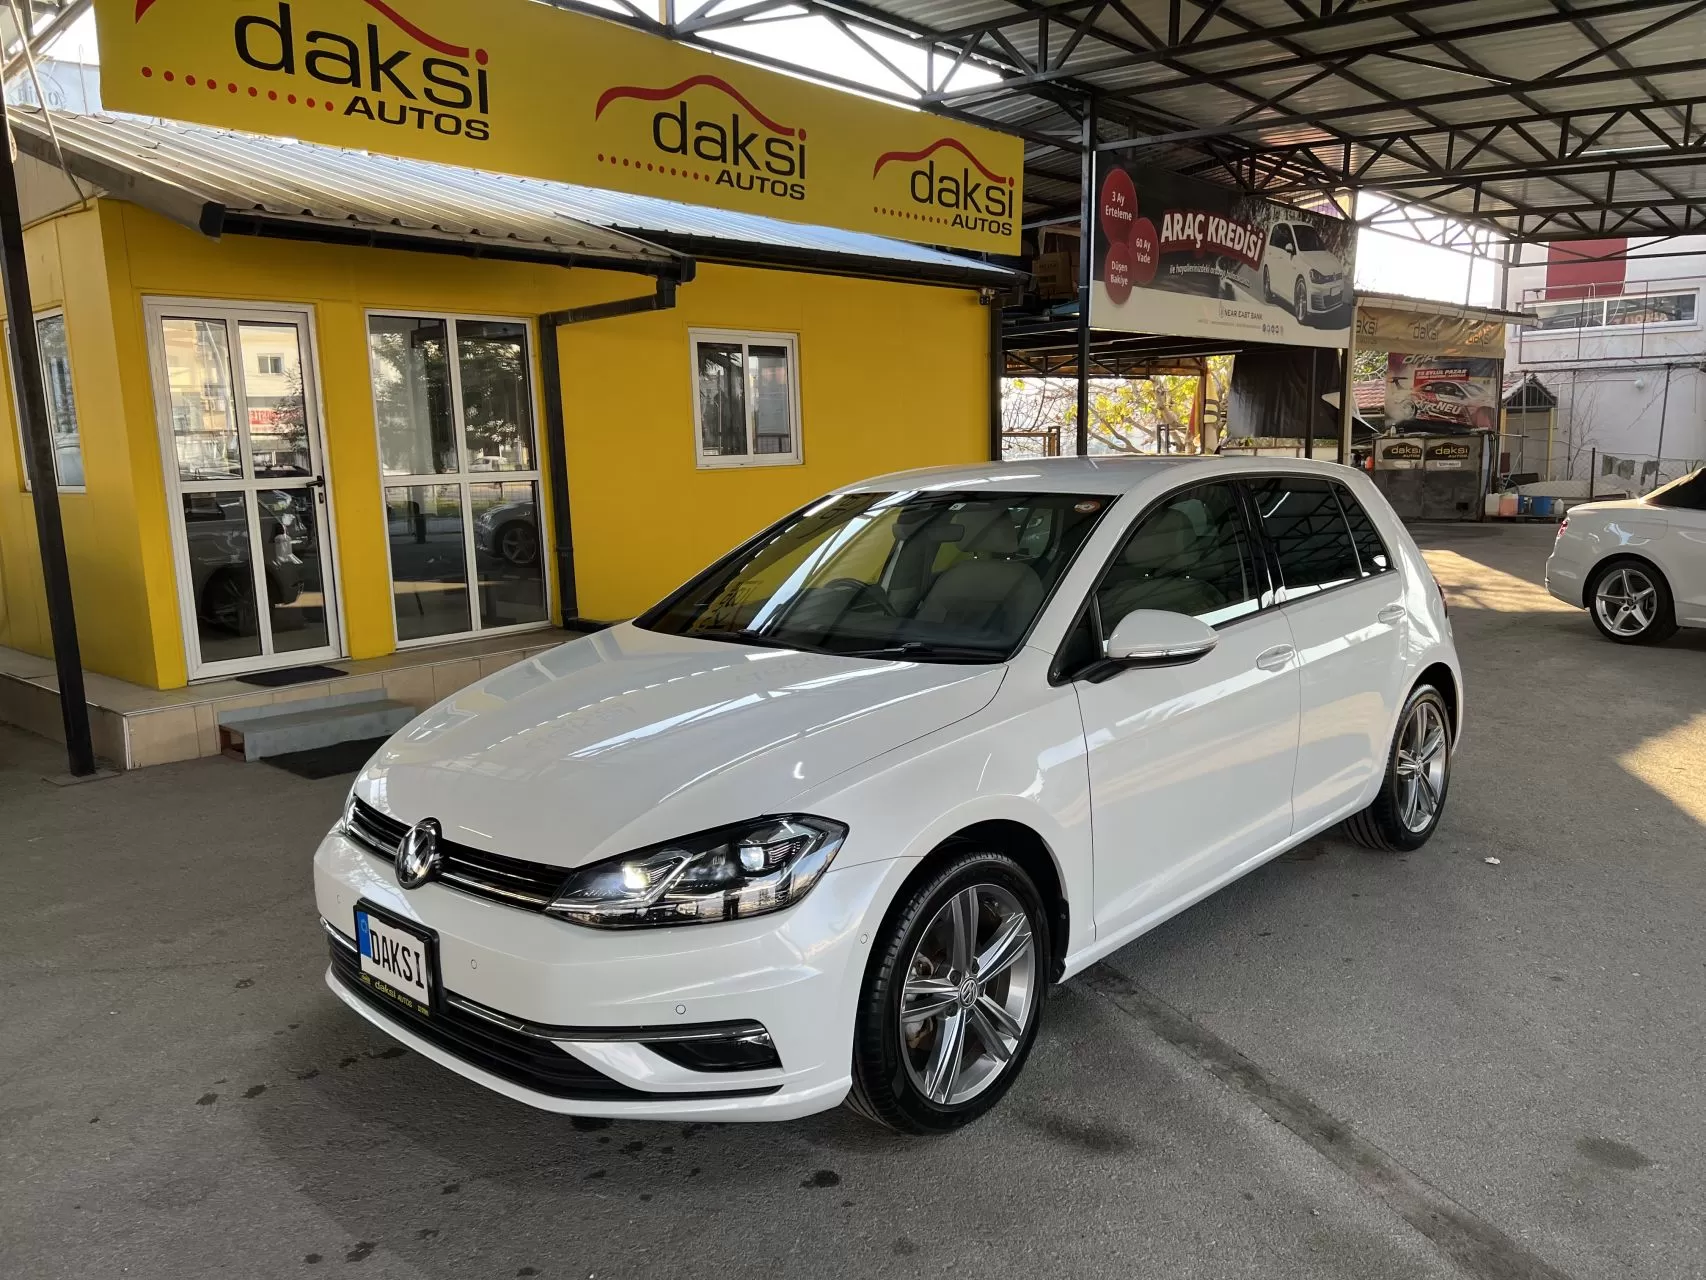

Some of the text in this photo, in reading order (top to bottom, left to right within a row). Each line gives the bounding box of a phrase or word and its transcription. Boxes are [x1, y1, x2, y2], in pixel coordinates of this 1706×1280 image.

[234, 2, 490, 115] daksi
[343, 96, 490, 141] AUTOS
[652, 100, 807, 180] daksi
[715, 170, 806, 201] AUTOS
[910, 160, 1015, 219] daksi
[1111, 191, 1125, 206] 3 Ay
[1105, 205, 1132, 221] Erteleme
[951, 213, 1013, 236] AUTOS
[1135, 238, 1151, 252] 60 Ay
[1160, 213, 1263, 261] ARAÇ KREDİSİ
[1136, 252, 1151, 263] Vade
[1111, 261, 1128, 273] Düşen
[1110, 274, 1128, 287] Bakiye
[1224, 308, 1237, 317] NEAR
[1356, 318, 1378, 336] aksi
[1391, 445, 1421, 454] daksi
[1435, 446, 1468, 455] daksi
[370, 929, 425, 989] DAKSI
[374, 981, 397, 999] daksi
